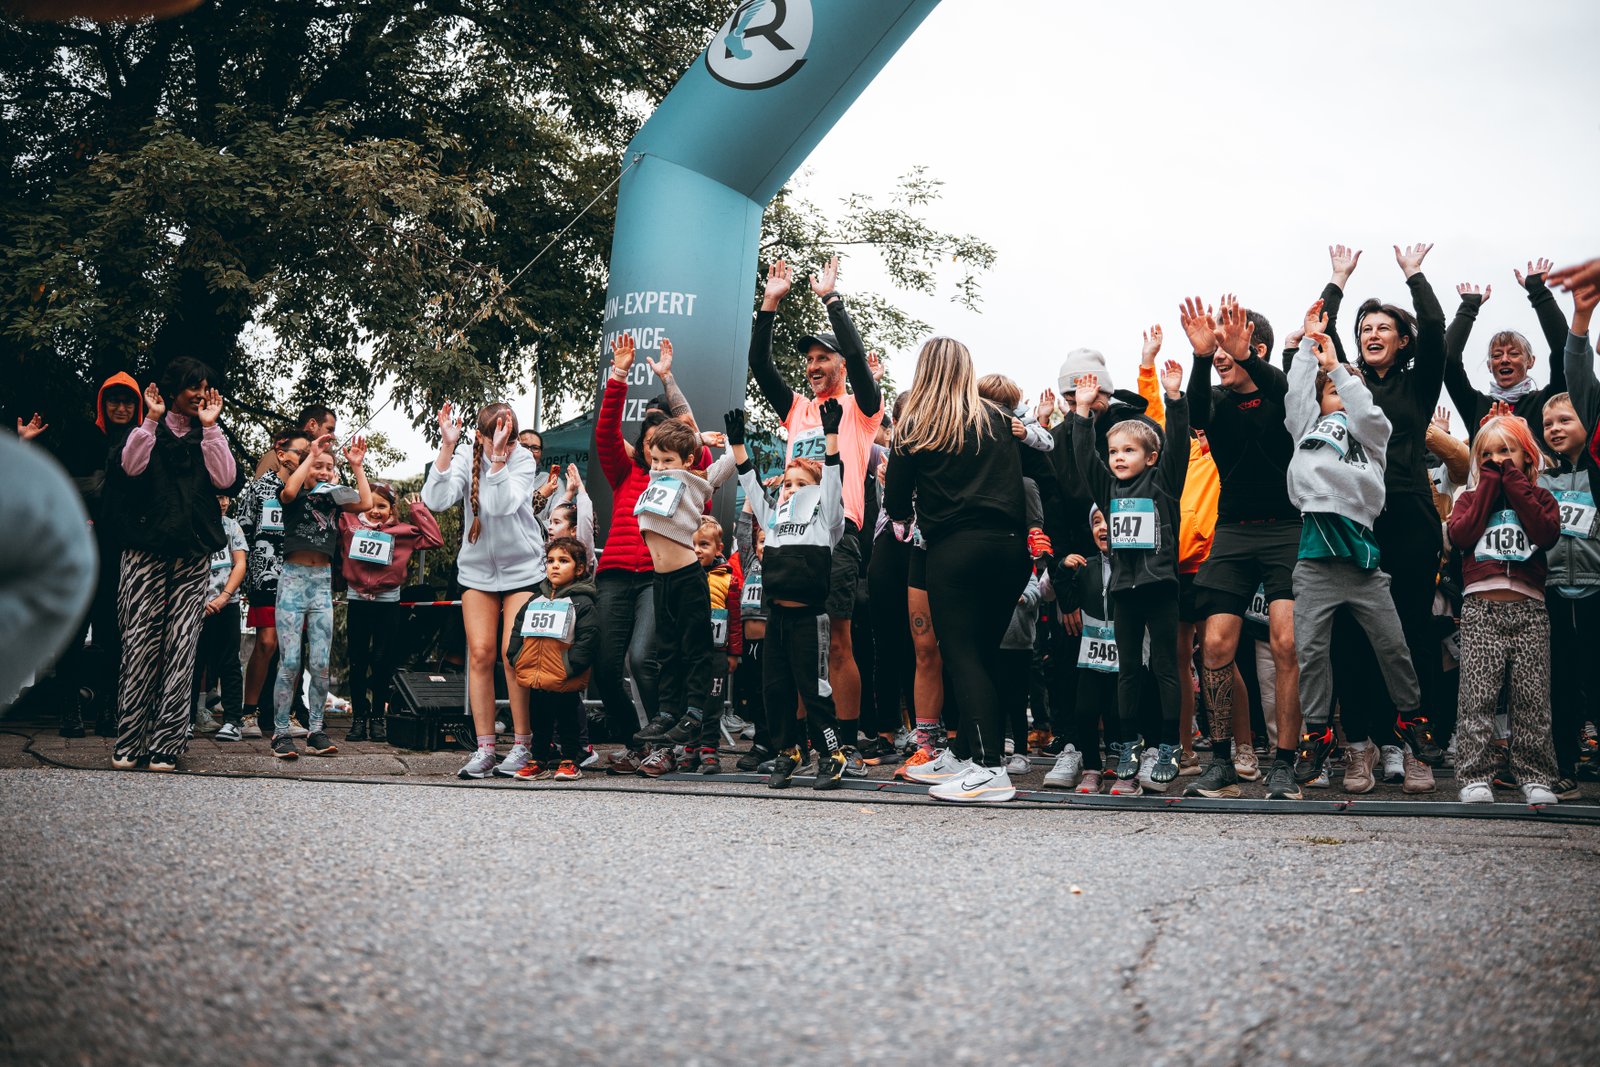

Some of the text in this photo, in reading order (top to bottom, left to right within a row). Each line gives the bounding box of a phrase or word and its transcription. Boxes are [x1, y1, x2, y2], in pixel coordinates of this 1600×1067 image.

[604, 291, 697, 322] UN-EXPERT
[621, 399, 649, 421] IZE
[793, 438, 826, 458] 375
[541, 452, 589, 469] xpert va
[1561, 505, 1585, 526] 37
[1112, 516, 1142, 538] 547
[359, 540, 382, 556] 527
[1485, 527, 1525, 551] 1138
[210, 551, 226, 561] 40
[531, 613, 556, 629] 551
[1088, 641, 1118, 661] 548
